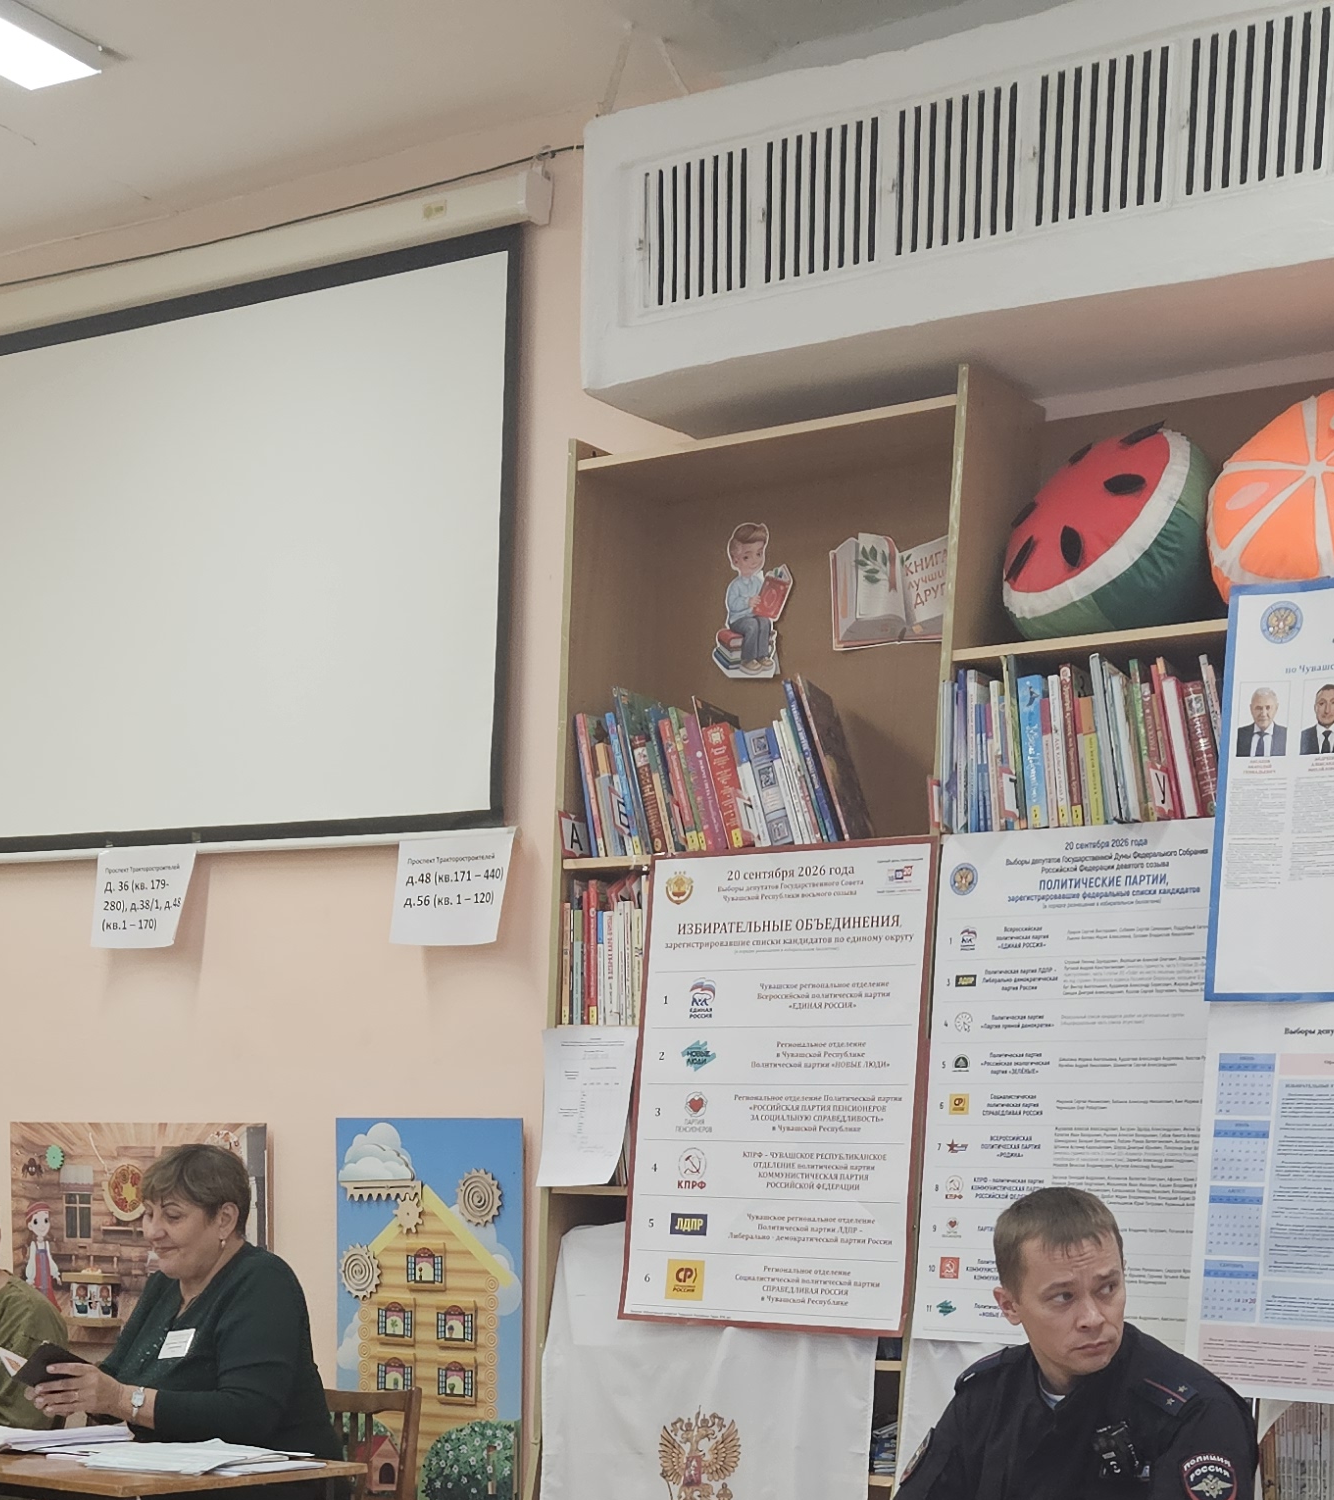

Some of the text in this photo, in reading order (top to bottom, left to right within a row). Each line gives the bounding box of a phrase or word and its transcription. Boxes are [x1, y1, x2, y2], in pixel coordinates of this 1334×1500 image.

[908, 570, 946, 592] лучши
[914, 582, 946, 609] ДРУГ
[1285, 666, 1297, 674] по
[570, 823, 583, 851] А
[1064, 837, 1148, 850] 20 сентября 2026 года
[407, 853, 495, 866] Проспект Тракторостроителей
[130, 863, 180, 873] Тракторостроителей
[726, 864, 855, 881] 20 сентября 2026 года
[406, 872, 431, 886] д.48
[434, 870, 472, 886] (кв.171
[483, 867, 504, 881] 440)
[1038, 872, 1169, 891] ПОЛИТИЧЕСКИЕ ПАРТИИ,
[104, 879, 169, 894] Д. 36 (кв. 179-
[103, 900, 128, 913] 280),
[129, 898, 162, 913] д.38/1,
[403, 895, 430, 908] д.56
[433, 894, 453, 908] (кв.
[456, 894, 462, 905] 1
[473, 890, 494, 905] 120)
[101, 919, 127, 932] (кв.1
[138, 918, 157, 931] 170)
[678, 914, 902, 935] ИЗБИРАТЕЛЬНЫЕ ОБЪЕДИНЕНИЯ,
[664, 939, 751, 950] зарегистрировавшие
[752, 937, 782, 945] списки
[782, 936, 833, 946] кандидатов
[846, 934, 884, 944] единому
[884, 933, 914, 943] округу
[677, 1180, 707, 1191] КПРФ
[675, 1217, 704, 1232] ЛДПР
[1184, 1455, 1231, 1471] ПОЛИЦИЯ
[1189, 1465, 1230, 1482] РОССИЯ
